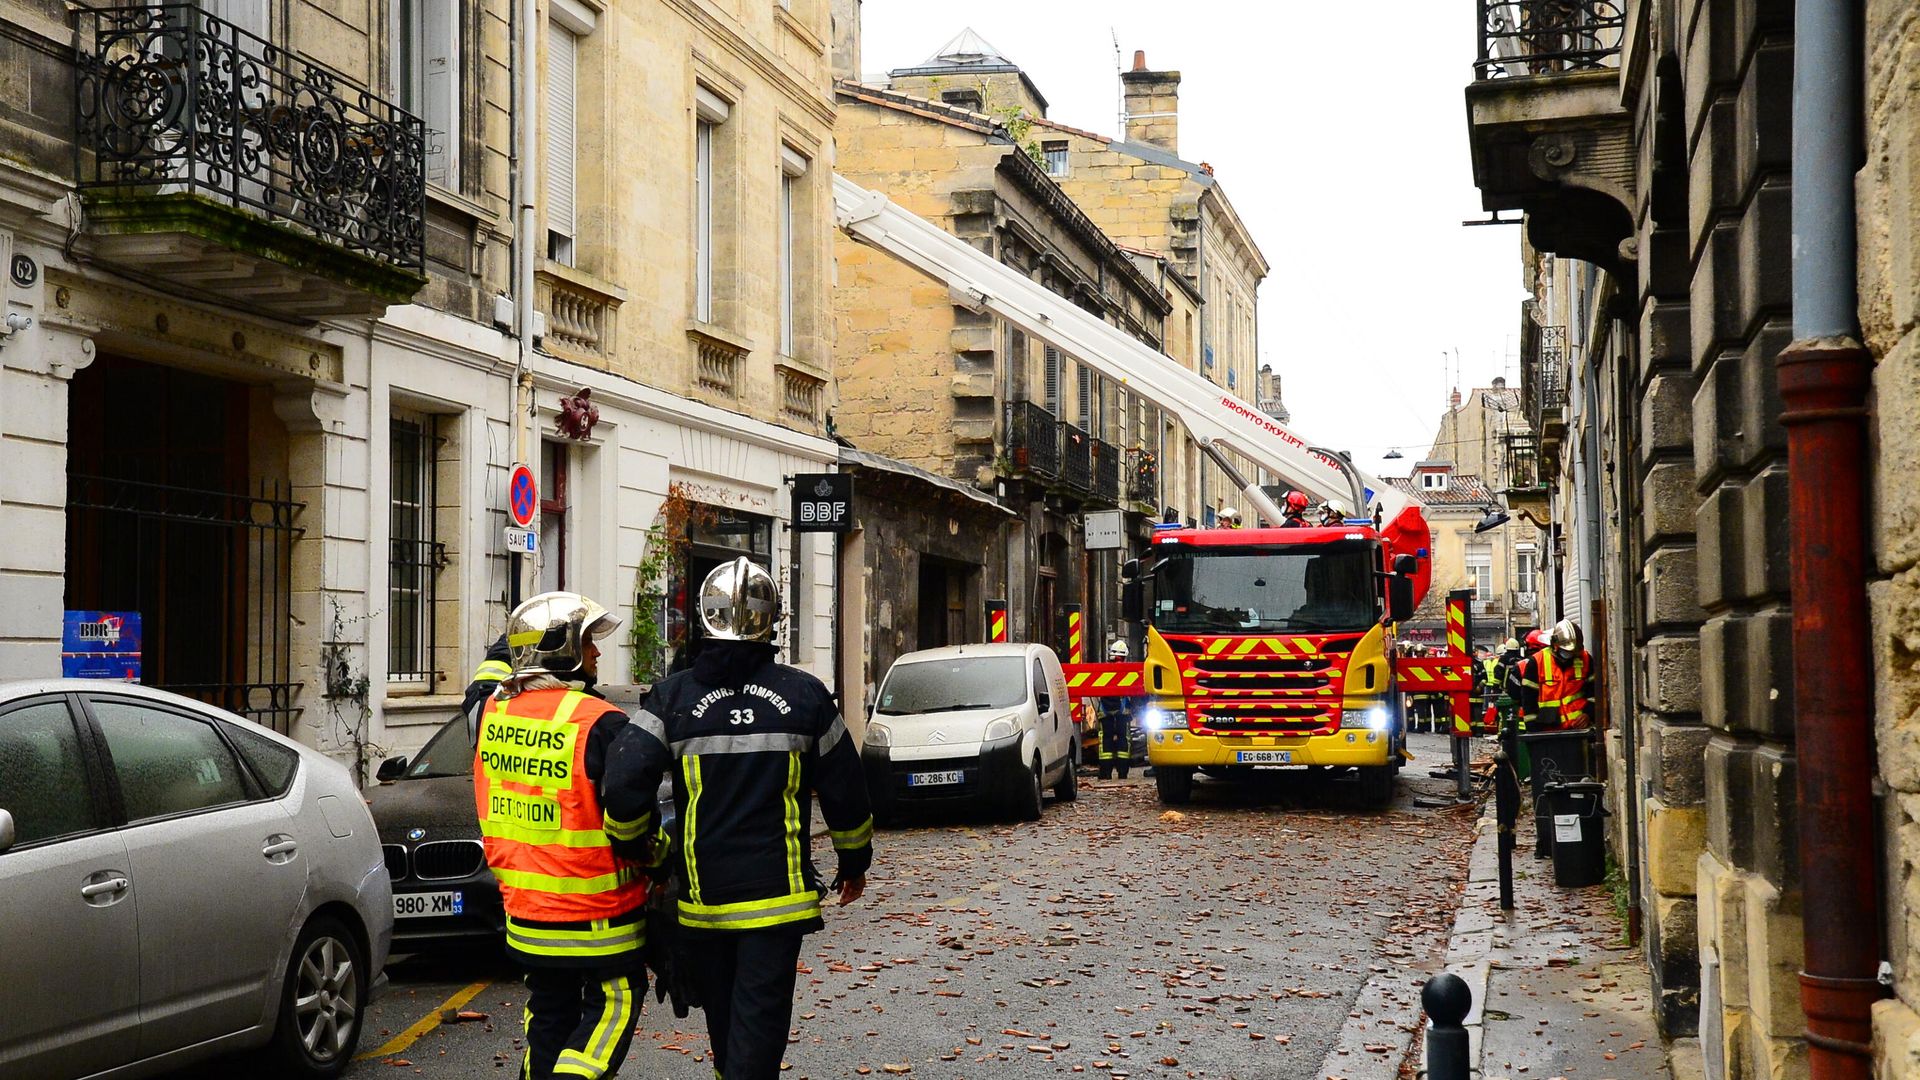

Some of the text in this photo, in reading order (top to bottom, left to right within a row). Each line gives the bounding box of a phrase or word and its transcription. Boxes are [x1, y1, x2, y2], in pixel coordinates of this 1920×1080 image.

[16, 260, 32, 281] 62
[1221, 397, 1263, 426] BRONTO
[1263, 422, 1304, 449] SKYLIFT
[800, 501, 846, 522] BBF
[509, 533, 526, 546] SAUF
[80, 623, 108, 637] BDR
[692, 684, 792, 718] SAPEURS POMPIERS
[729, 708, 755, 725] 33
[486, 723, 566, 750] SAPEURS
[481, 750, 568, 779] POMPIERS
